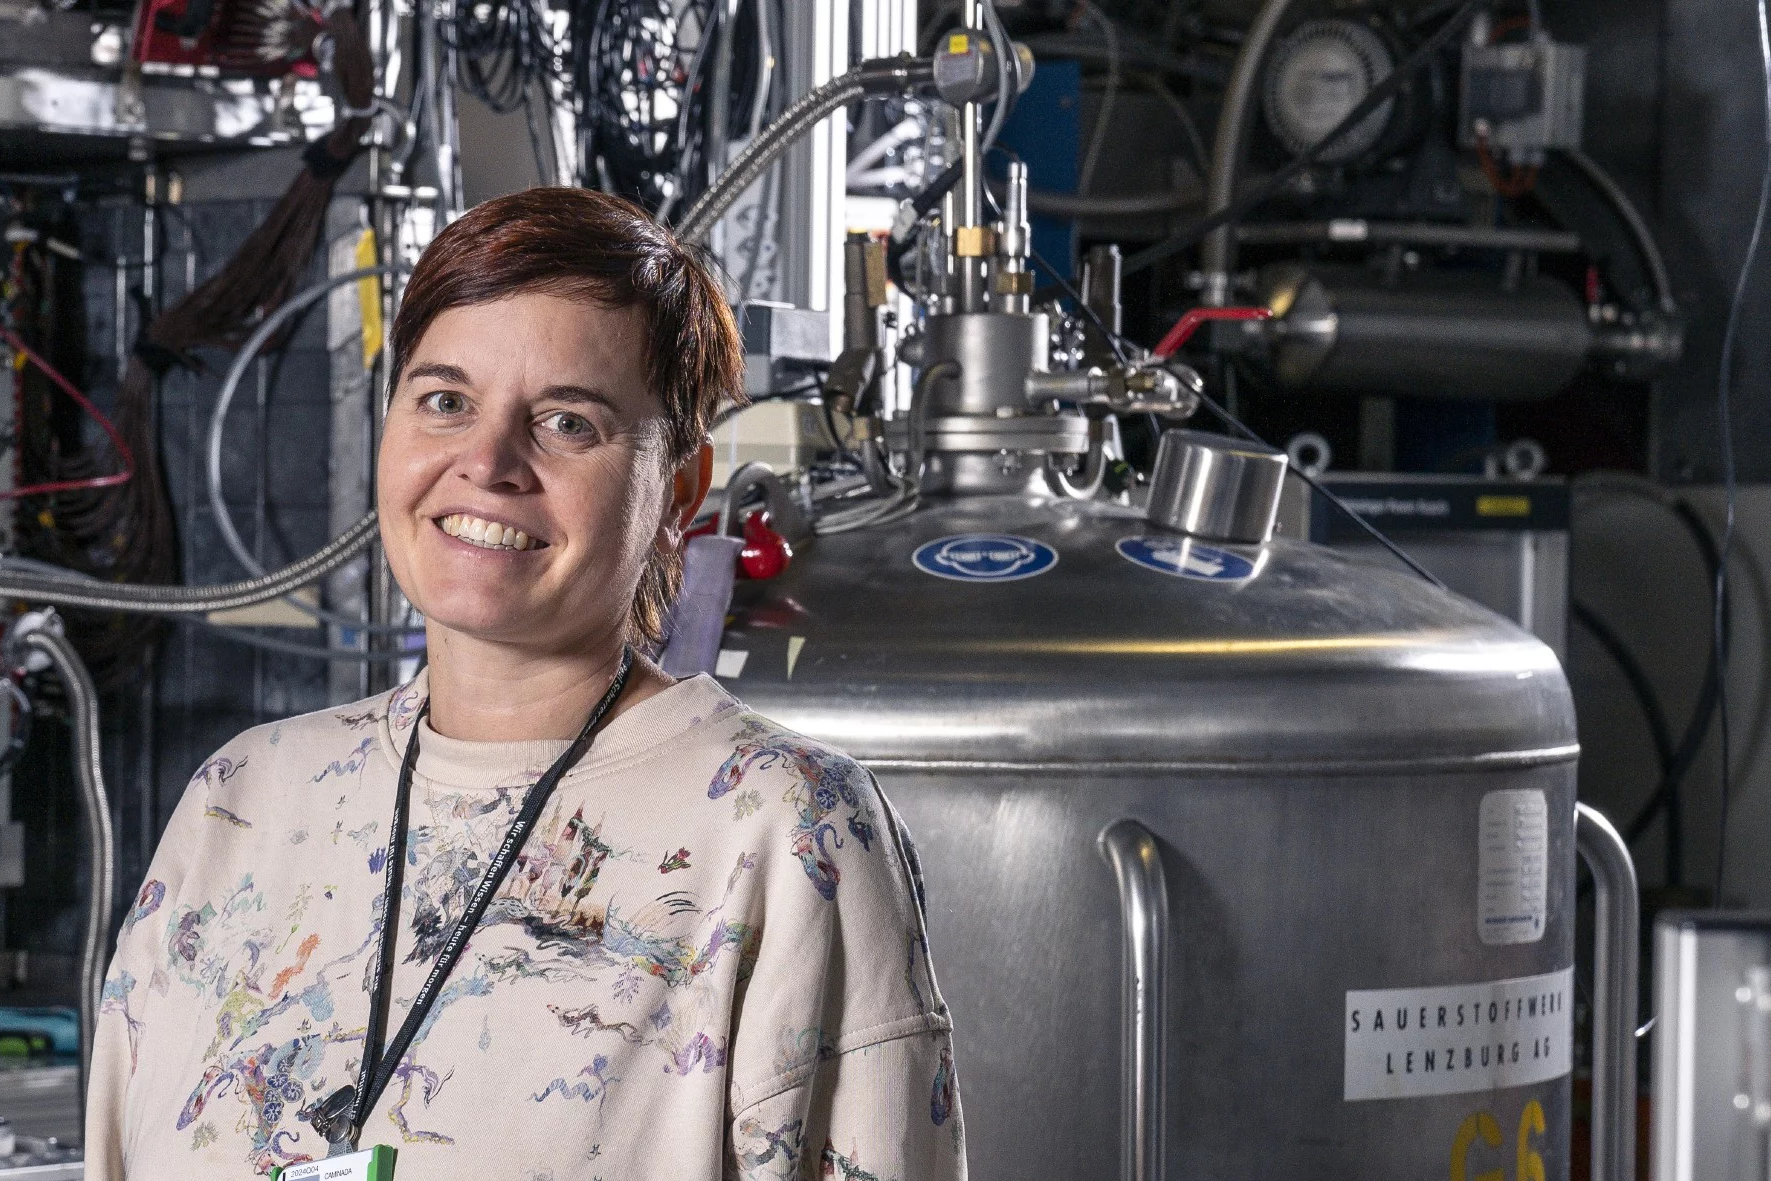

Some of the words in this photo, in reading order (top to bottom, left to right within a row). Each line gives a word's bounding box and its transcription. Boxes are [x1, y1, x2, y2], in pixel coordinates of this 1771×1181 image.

[510, 821, 526, 837] Wir
[488, 838, 514, 878] schaffen
[467, 880, 492, 913] Wissen
[446, 924, 468, 952] heute
[438, 954, 450, 968] für
[416, 969, 439, 1005] morgen
[1386, 1041, 1520, 1075] LENZBURG
[1534, 1036, 1550, 1059] AG
[290, 1165, 319, 1178] 2024Q04
